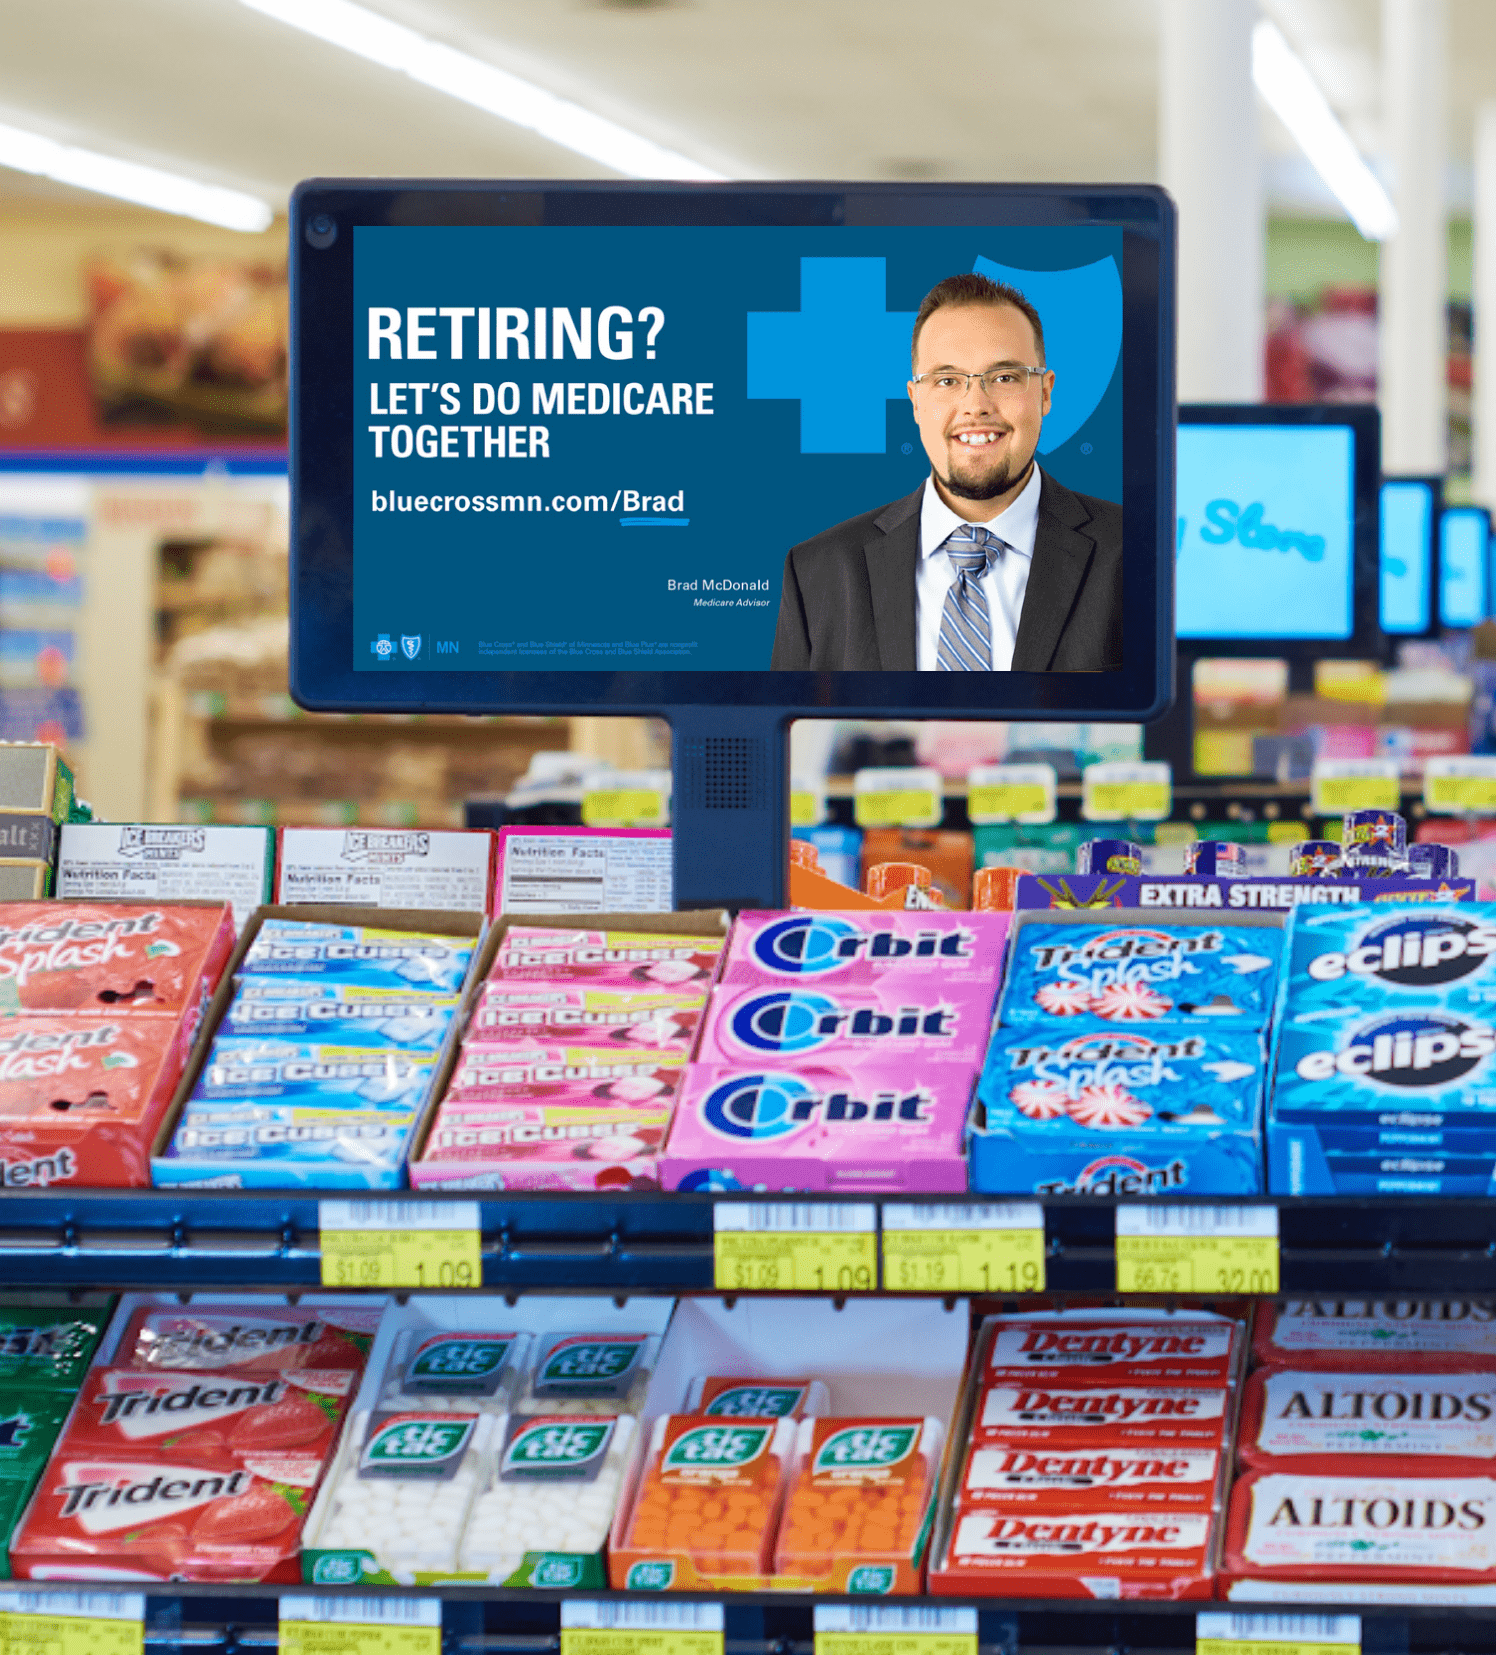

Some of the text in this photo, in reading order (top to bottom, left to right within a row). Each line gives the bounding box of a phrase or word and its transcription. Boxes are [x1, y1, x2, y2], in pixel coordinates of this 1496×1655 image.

[368, 305, 665, 361] RETIRING?
[370, 381, 714, 415] LET'S DO MEDICARE
[368, 424, 550, 458] TOGETHER
[372, 489, 685, 512] bluecrossmn.com/Brad
[667, 579, 769, 591] Brad McDonald
[693, 598, 770, 607] Medicare Advisor
[437, 641, 459, 653] MN
[63, 869, 157, 881] Nutrition Facts
[287, 874, 381, 885] Nutrition Facts
[1140, 884, 1223, 907] EXTRA
[1229, 884, 1360, 907] STRENGTH
[751, 915, 974, 974] Orbit
[1033, 932, 1220, 970] Trident
[1058, 950, 1201, 998] Splash
[729, 990, 956, 1052] Orbit
[1008, 1037, 1203, 1068] Trident
[1034, 1057, 1183, 1101] Splash
[701, 1073, 932, 1141] Orbit
[450, 1342, 493, 1361] tic
[577, 1344, 620, 1362] tic
[1018, 1331, 1206, 1358] Dentyne
[428, 1357, 481, 1372] tac
[558, 1359, 609, 1374] tac
[97, 1381, 286, 1424] Trident
[740, 1389, 783, 1408] tic
[1009, 1391, 1201, 1419] Dentyne
[1278, 1390, 1492, 1422] ALTOIDS
[405, 1426, 449, 1444] tic
[545, 1428, 589, 1446] tic
[704, 1429, 749, 1448] tic
[851, 1430, 898, 1448] tic
[384, 1440, 442, 1456] tac
[525, 1442, 582, 1457] tac
[685, 1444, 740, 1460] tac
[834, 1445, 888, 1461] tac
[996, 1452, 1190, 1481] Dentyne
[57, 1471, 250, 1518] Trident
[1265, 1497, 1486, 1531] ALTOIDS
[984, 1518, 1180, 1546] Dentyne
